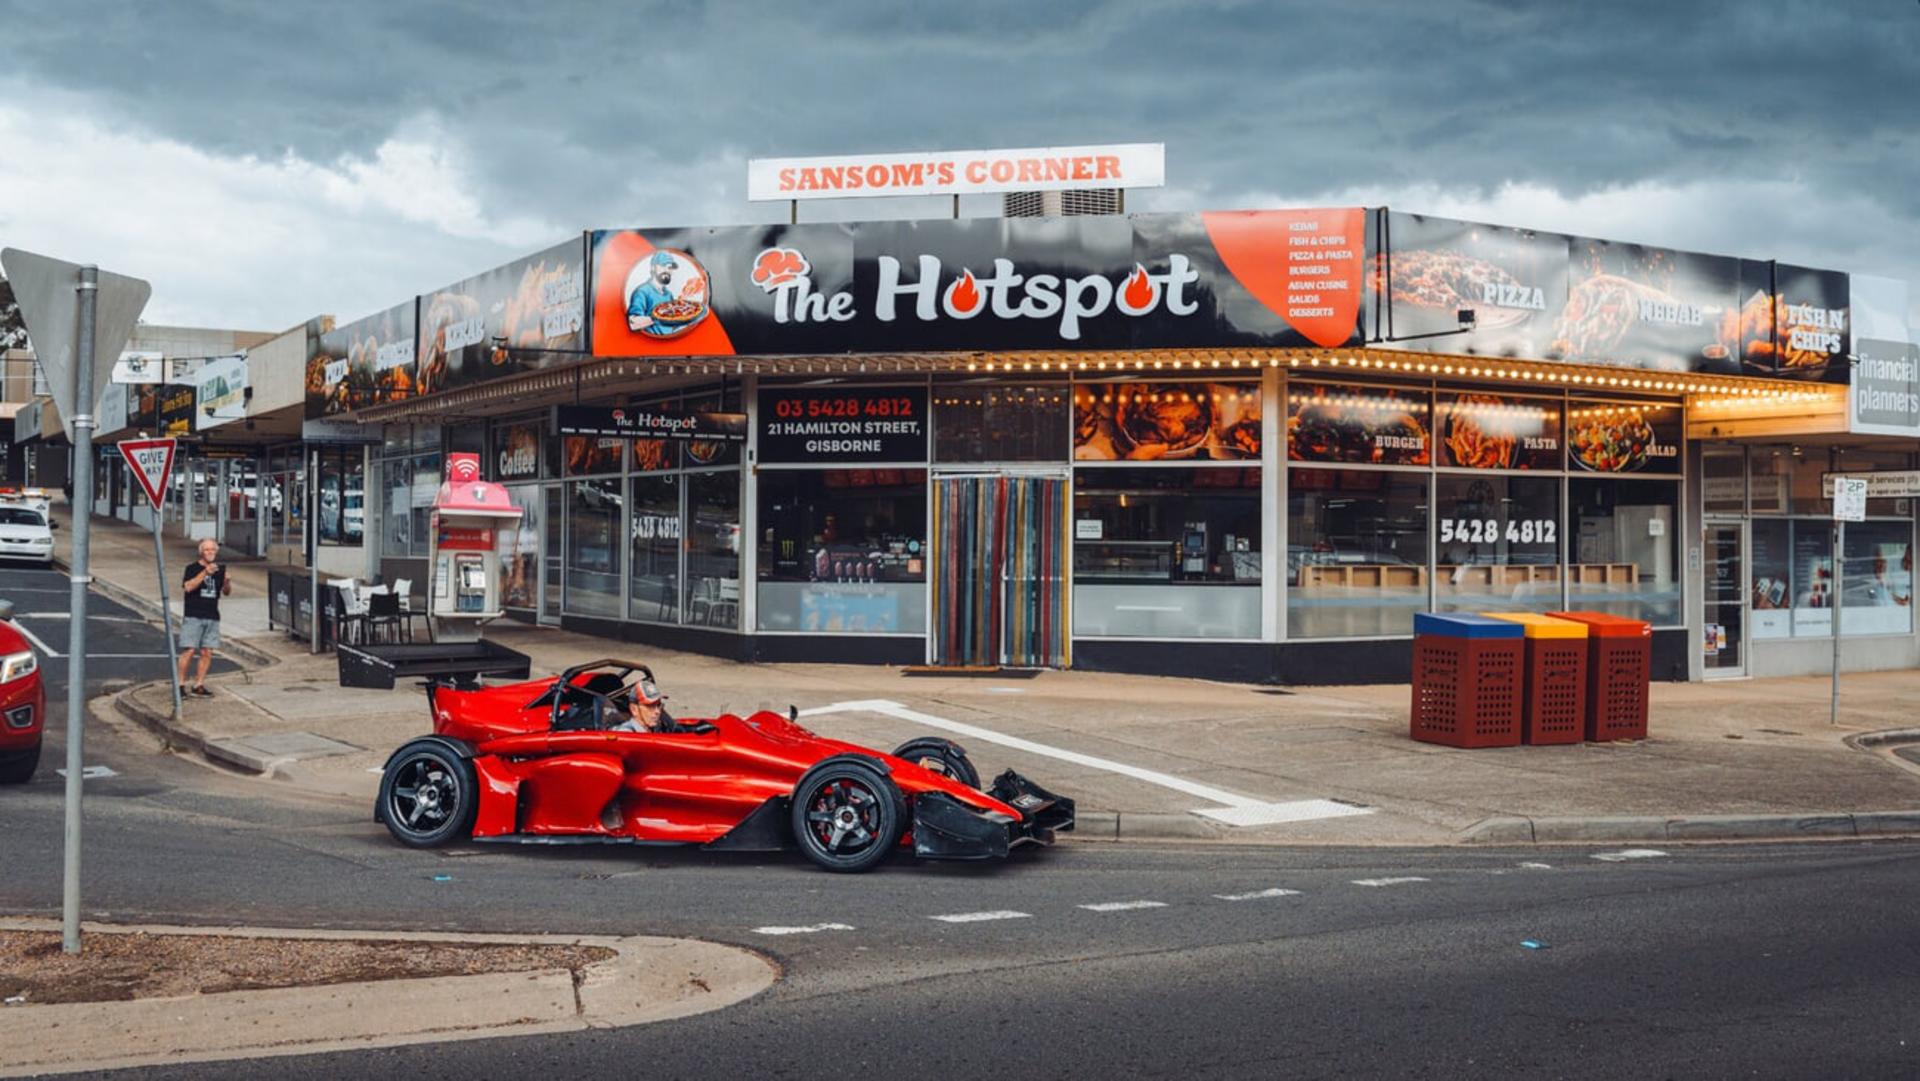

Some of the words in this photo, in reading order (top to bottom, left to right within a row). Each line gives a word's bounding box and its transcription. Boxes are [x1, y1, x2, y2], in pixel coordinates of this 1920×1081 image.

[780, 161, 955, 192] SANSOM'S
[965, 154, 1123, 184] CORNER
[1289, 223, 1318, 231] KEBAB
[1289, 237, 1309, 245] FISH
[1310, 237, 1318, 245] &
[1320, 236, 1345, 245] CHIPS
[1289, 252, 1314, 260] PIZZA
[1316, 251, 1323, 259] &
[1325, 250, 1353, 259] PASTA
[1289, 266, 1330, 275] BURGERS
[1288, 281, 1315, 290] ASIAN
[770, 272, 857, 323] The
[875, 253, 1200, 341] Hotspot
[1482, 282, 1545, 311] PIZZA
[1289, 308, 1334, 317] DESSERTS
[1788, 304, 1826, 326] FISH
[1827, 309, 1844, 330] N
[1791, 330, 1842, 354] CHIPS
[1859, 354, 1919, 382] financial
[1859, 386, 1919, 414] planners
[776, 399, 803, 417] 03
[808, 399, 859, 417] 5428
[864, 399, 912, 416] 4812
[615, 416, 634, 427] The
[638, 413, 698, 431] Hotspot
[768, 423, 781, 435] 21
[784, 422, 862, 435] HAMILTON
[864, 421, 921, 435] STREET,
[806, 440, 881, 452] GISBORNE
[1375, 435, 1424, 450] BURGER
[1524, 438, 1557, 450] PASTA
[139, 451, 165, 465] GIVE
[1645, 445, 1677, 457] SALAD
[500, 450, 535, 476] Coffee
[1848, 482, 1865, 492] 2P
[632, 517, 655, 539] 5428
[657, 517, 680, 539] 4812
[1440, 518, 1499, 544] 5428
[1504, 518, 1557, 544] 4812
